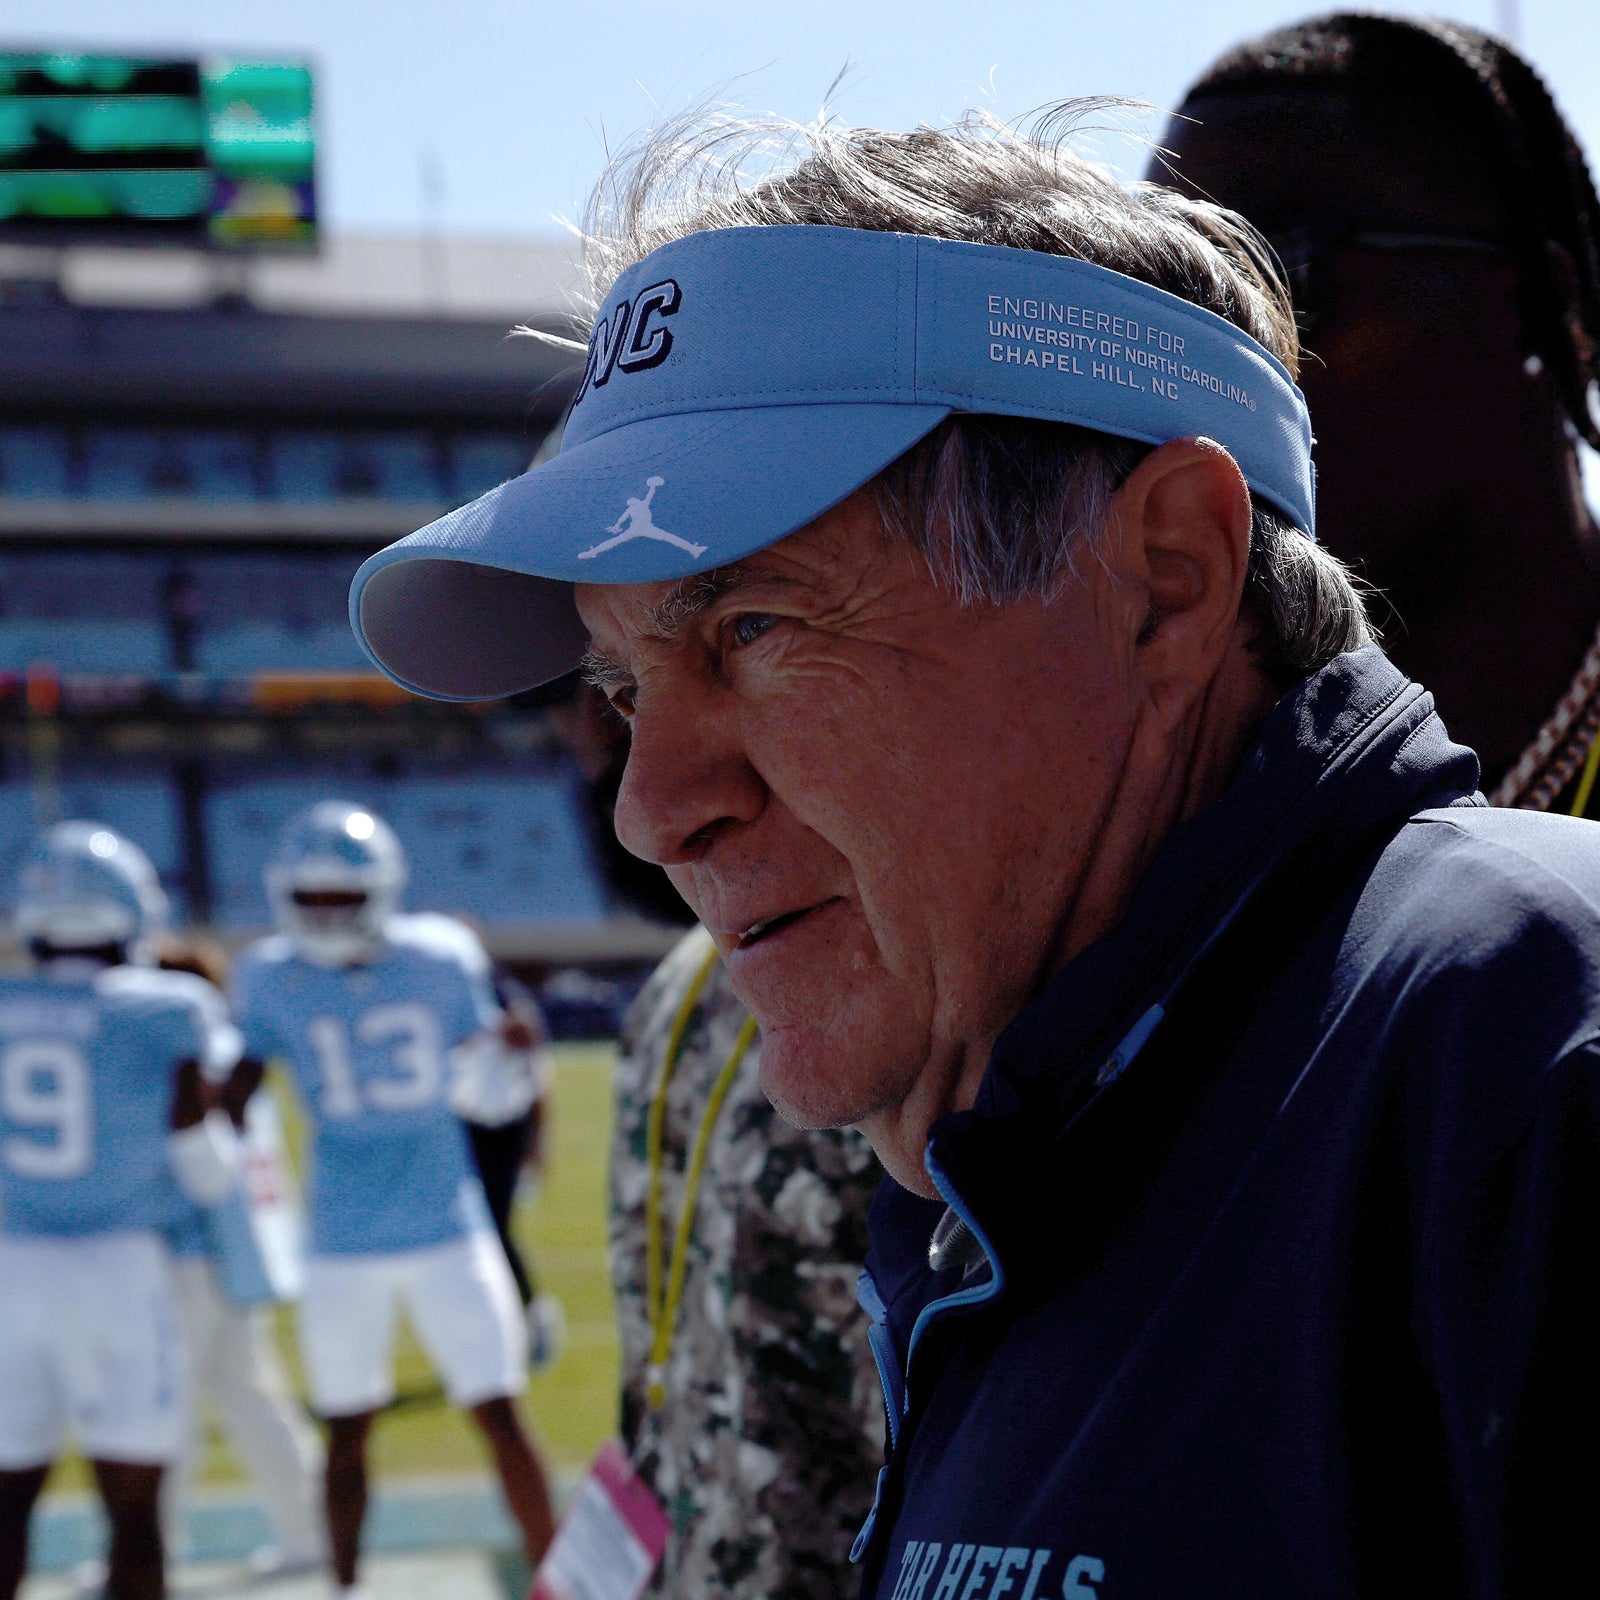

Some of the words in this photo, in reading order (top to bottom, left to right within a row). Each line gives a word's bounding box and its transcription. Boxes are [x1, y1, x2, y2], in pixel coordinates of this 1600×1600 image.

[574, 278, 682, 406] NC
[987, 295, 1139, 341] ENGINEERED
[1146, 326, 1185, 356] FOR
[988, 320, 1097, 352] UNIVERSITY
[1100, 340, 1123, 359] OF
[1125, 348, 1178, 377] NORTH
[989, 343, 1085, 375] CHAPEL
[1092, 361, 1146, 393] HILL,
[1152, 377, 1179, 401] NC
[310, 1003, 443, 1117] 13
[2, 1041, 93, 1180] 9
[891, 1540, 942, 1600] TAR
